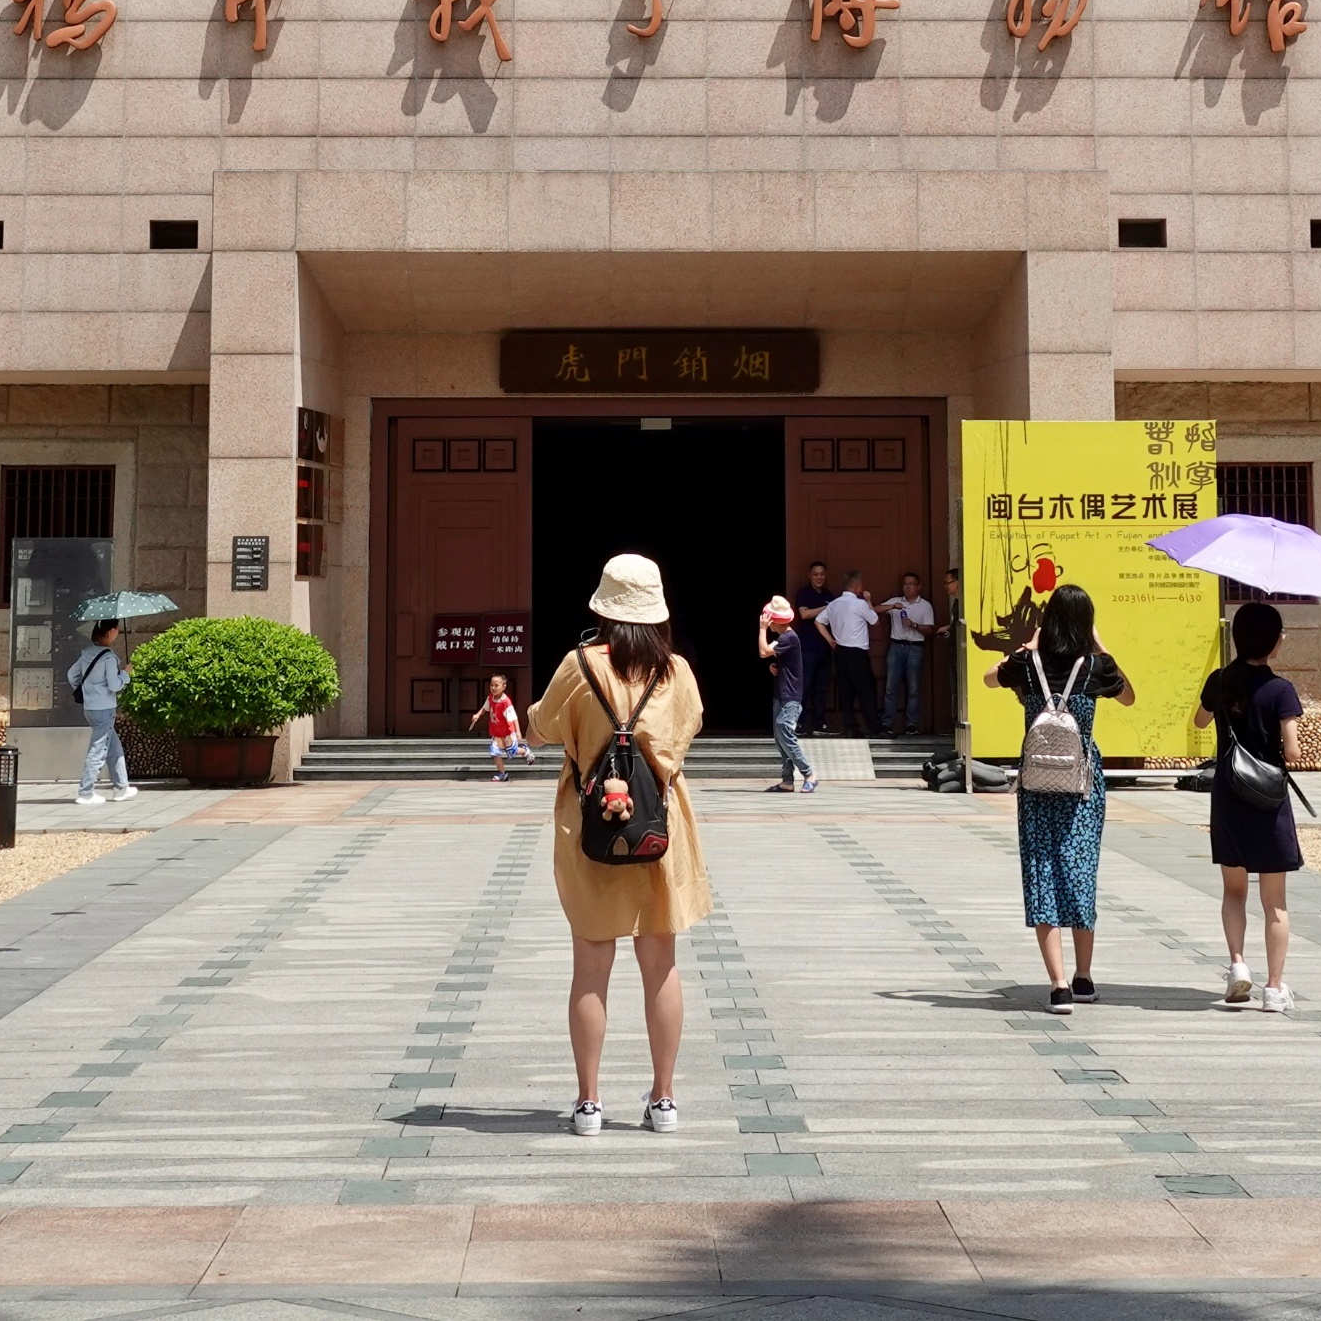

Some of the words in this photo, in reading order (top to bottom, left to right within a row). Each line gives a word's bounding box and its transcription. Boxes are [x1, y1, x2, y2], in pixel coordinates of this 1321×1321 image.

[986, 493, 1199, 521] 闽台木偶艺术展
[1036, 531, 1046, 540] of
[1049, 531, 1079, 542] Puppet
[1084, 531, 1099, 539] Art
[1104, 531, 1112, 539] in
[1117, 531, 1143, 541] Fujian
[1147, 531, 1163, 539] and
[436, 627, 476, 637] 参观请
[487, 625, 524, 633] 文明参观
[492, 635, 519, 643] 请保持
[435, 640, 475, 650] 戴口罩
[486, 645, 523, 653] 一米距离
